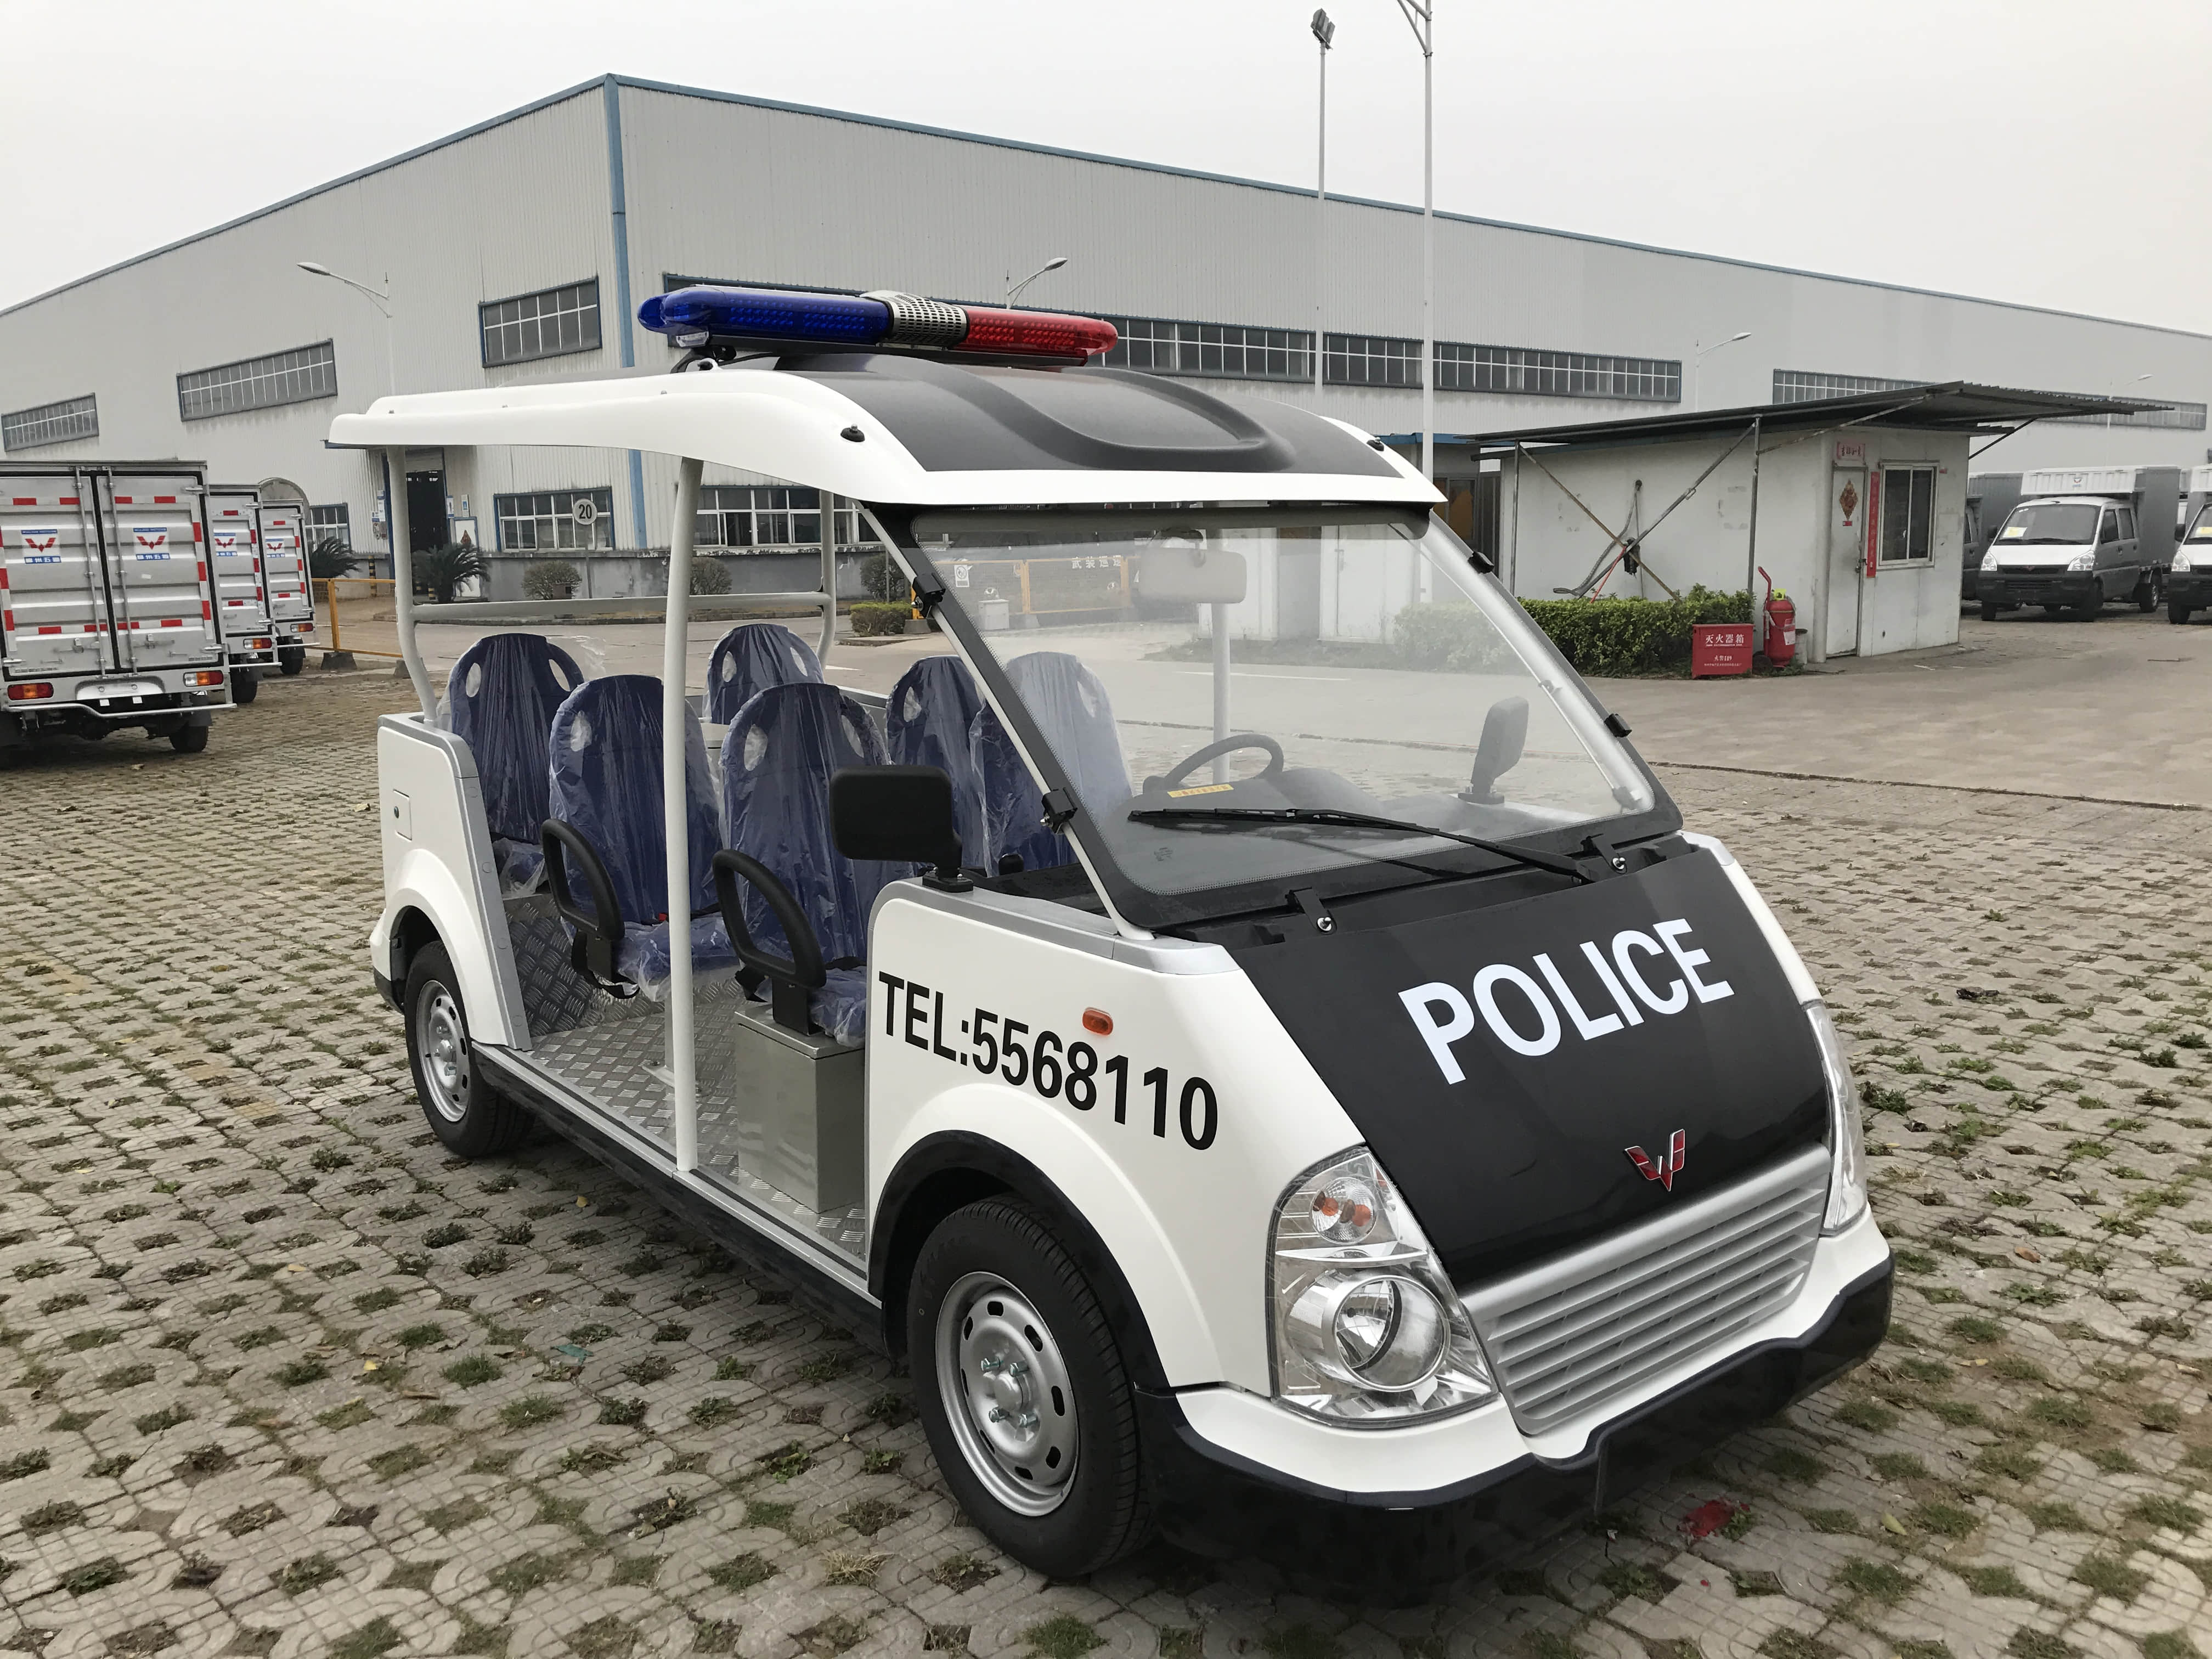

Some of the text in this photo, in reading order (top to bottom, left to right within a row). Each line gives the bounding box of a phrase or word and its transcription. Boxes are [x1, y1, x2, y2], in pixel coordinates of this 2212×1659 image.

[578, 504, 592, 519] 20
[1705, 634, 1744, 644] 灭火器箱
[1398, 918, 1735, 1085] POLICE
[879, 970, 1218, 1150] TEL:5568110
